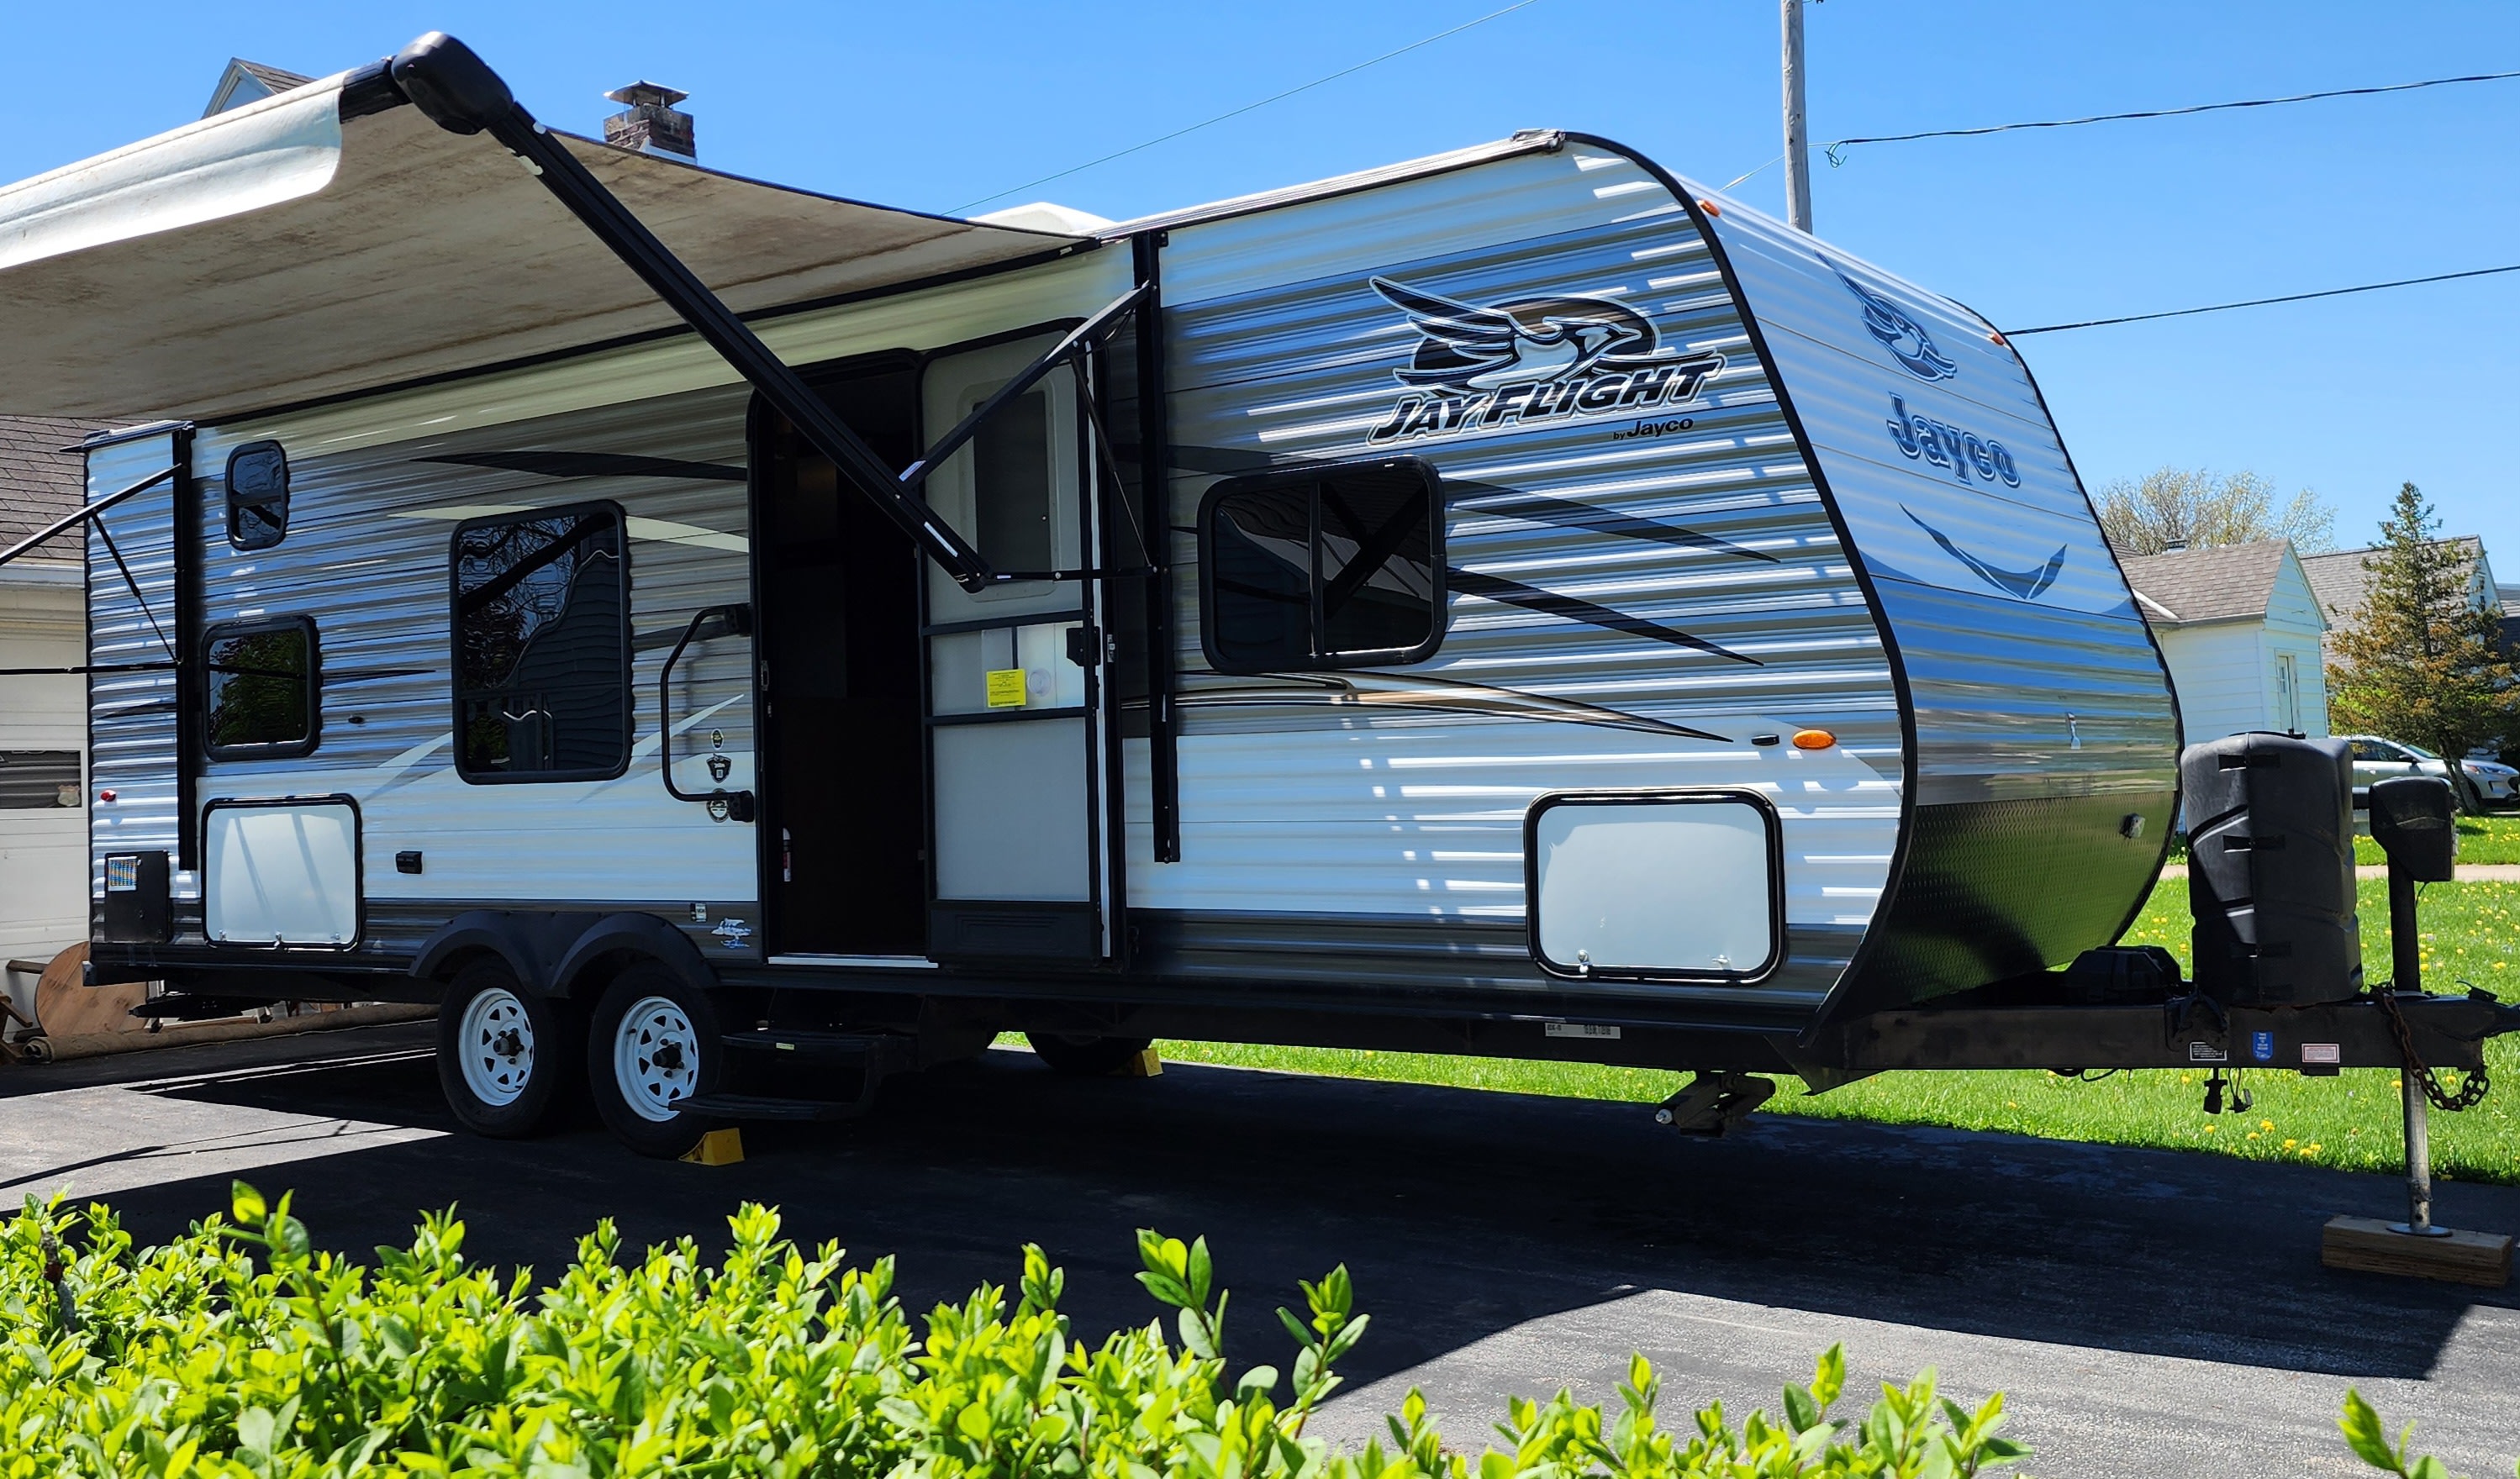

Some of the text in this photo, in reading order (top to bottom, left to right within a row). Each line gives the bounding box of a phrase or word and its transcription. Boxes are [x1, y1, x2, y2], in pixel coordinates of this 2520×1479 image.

[1368, 355, 1727, 445] JAY FLIGHT
[1613, 418, 1694, 440] by Jayco
[1887, 392, 2021, 487] Jayco
